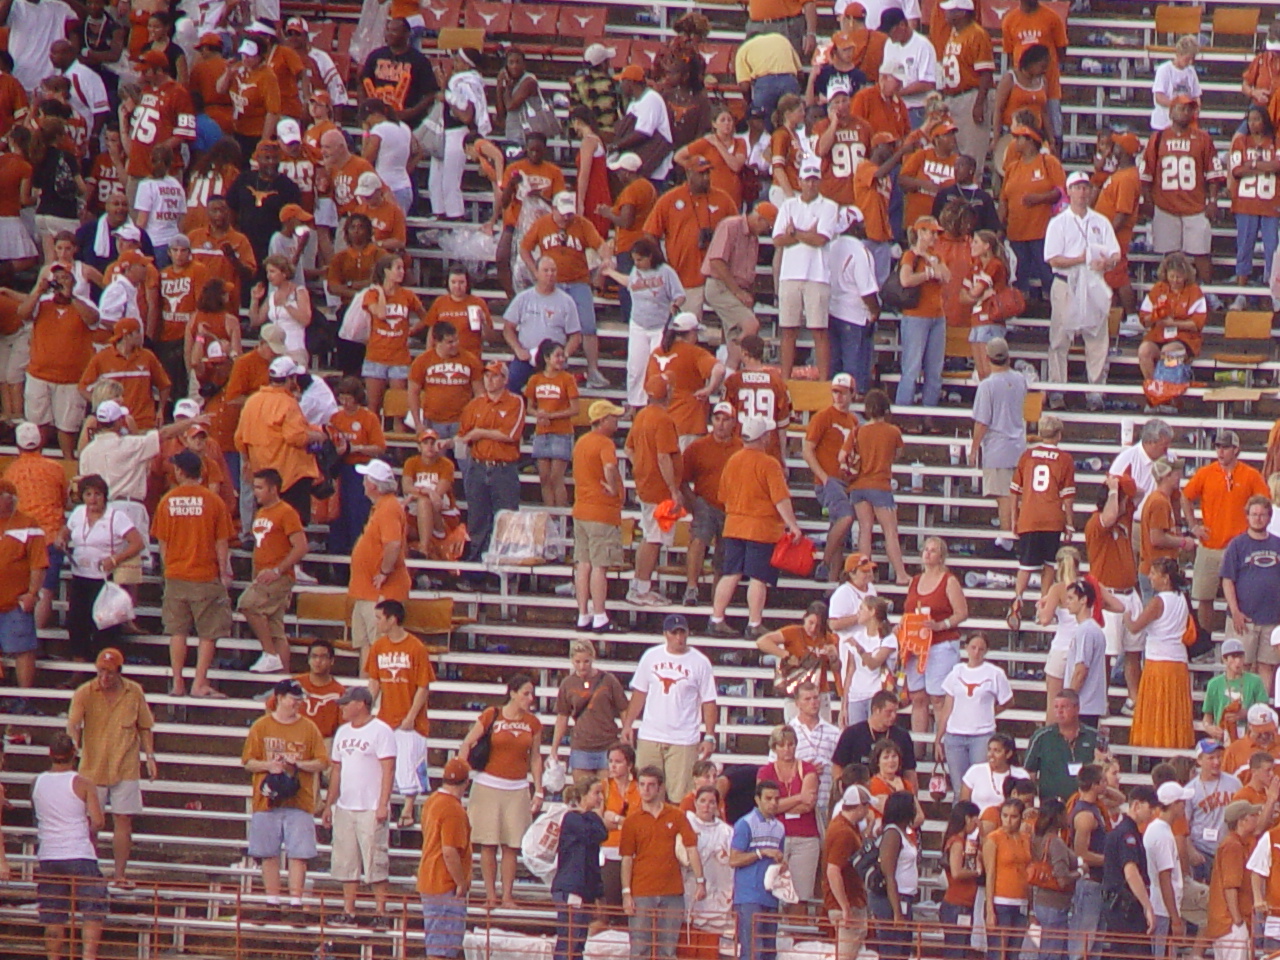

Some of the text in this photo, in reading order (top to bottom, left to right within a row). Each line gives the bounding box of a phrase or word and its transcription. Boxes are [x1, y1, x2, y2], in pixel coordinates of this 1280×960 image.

[834, 130, 858, 142] TEXAS
[1166, 139, 1191, 151] TEXAS
[1161, 156, 1196, 191] 28
[1239, 175, 1276, 200] 28
[161, 277, 191, 296] TEXAS
[384, 303, 407, 317] EXAS
[426, 362, 471, 378] TEXAS
[738, 389, 774, 424] 39
[1034, 465, 1050, 492] 8
[168, 497, 203, 507] TEXAS
[169, 507, 203, 517] PROUD
[652, 662, 691, 678] TEXAS
[493, 719, 532, 733] Texas
[336, 739, 370, 751] TEXAS
[1197, 790, 1233, 813] TEXA
